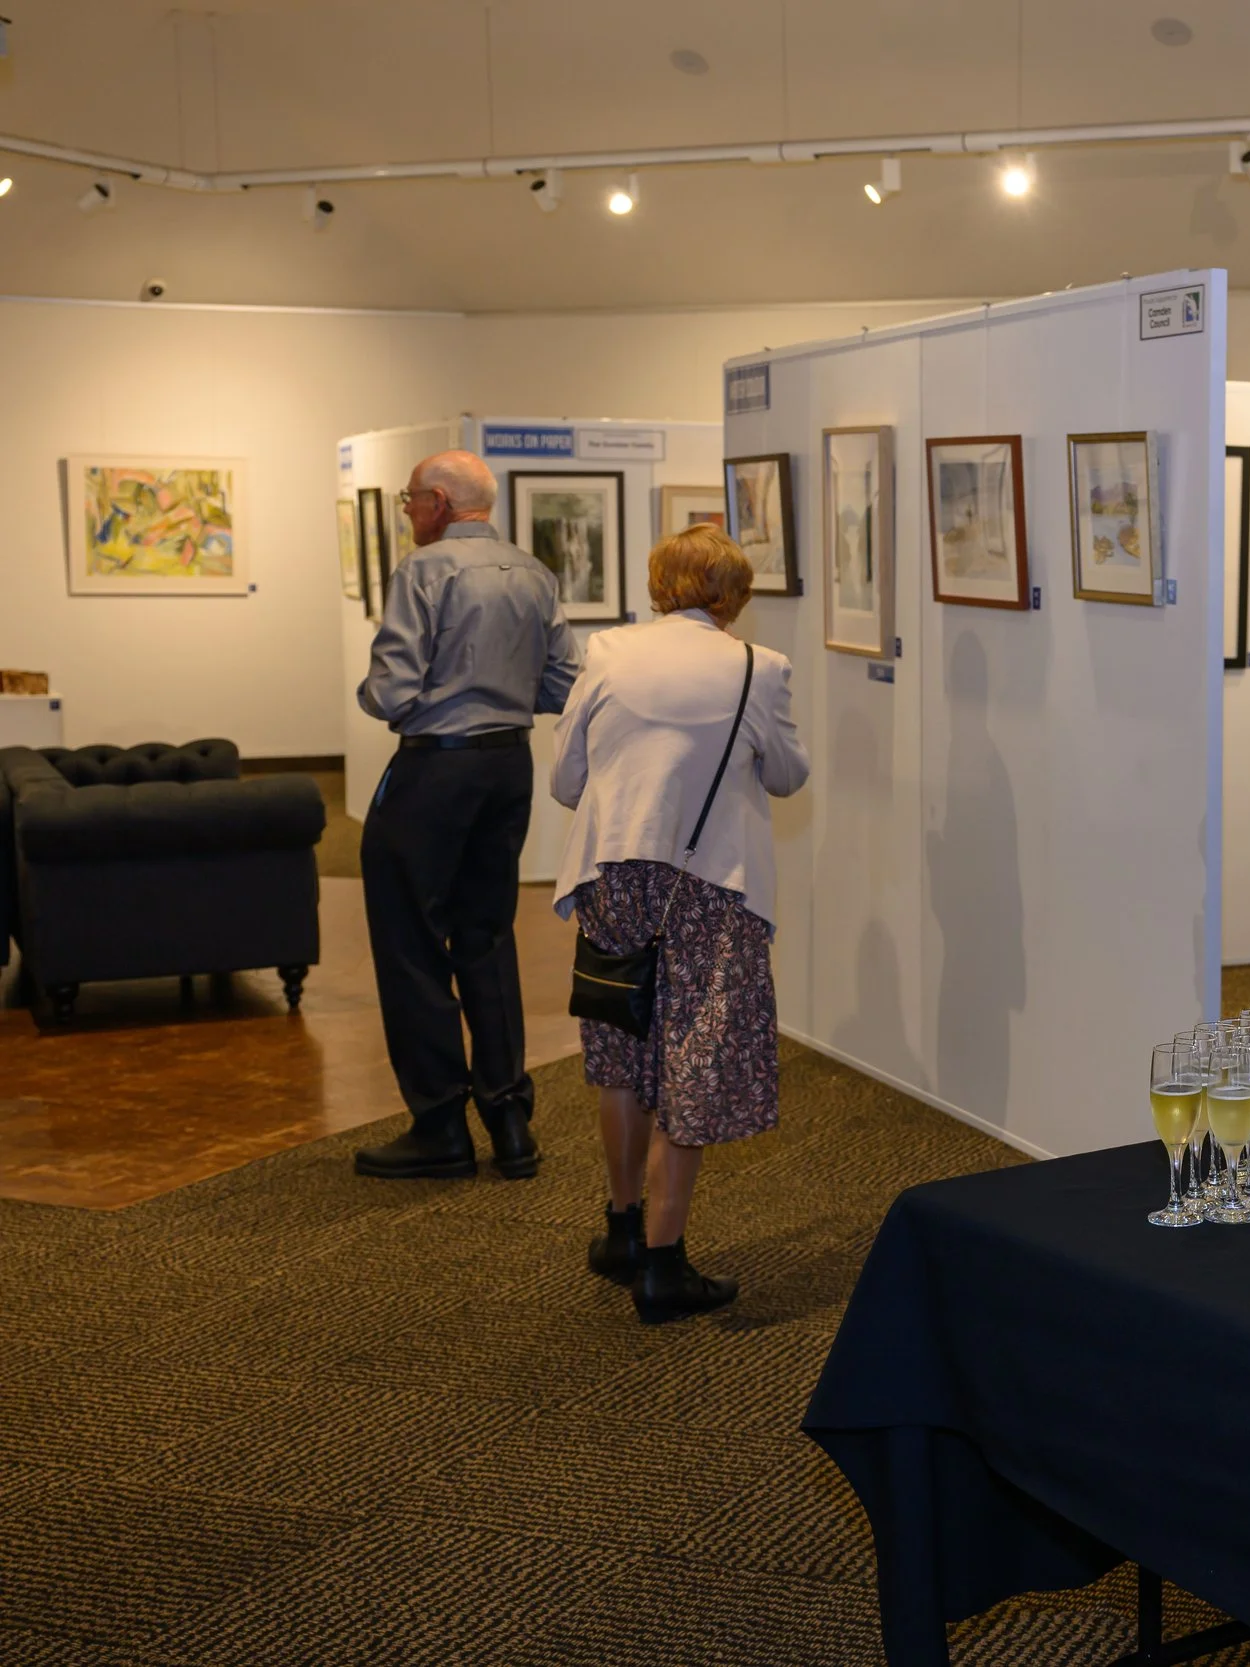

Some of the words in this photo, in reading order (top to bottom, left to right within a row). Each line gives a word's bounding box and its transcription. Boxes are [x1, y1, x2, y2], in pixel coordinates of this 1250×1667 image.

[1148, 307, 1172, 318] Camden
[1150, 317, 1170, 329] Council
[487, 433, 522, 448] WORKS
[524, 434, 539, 449] ON
[540, 434, 572, 449] PAPER
